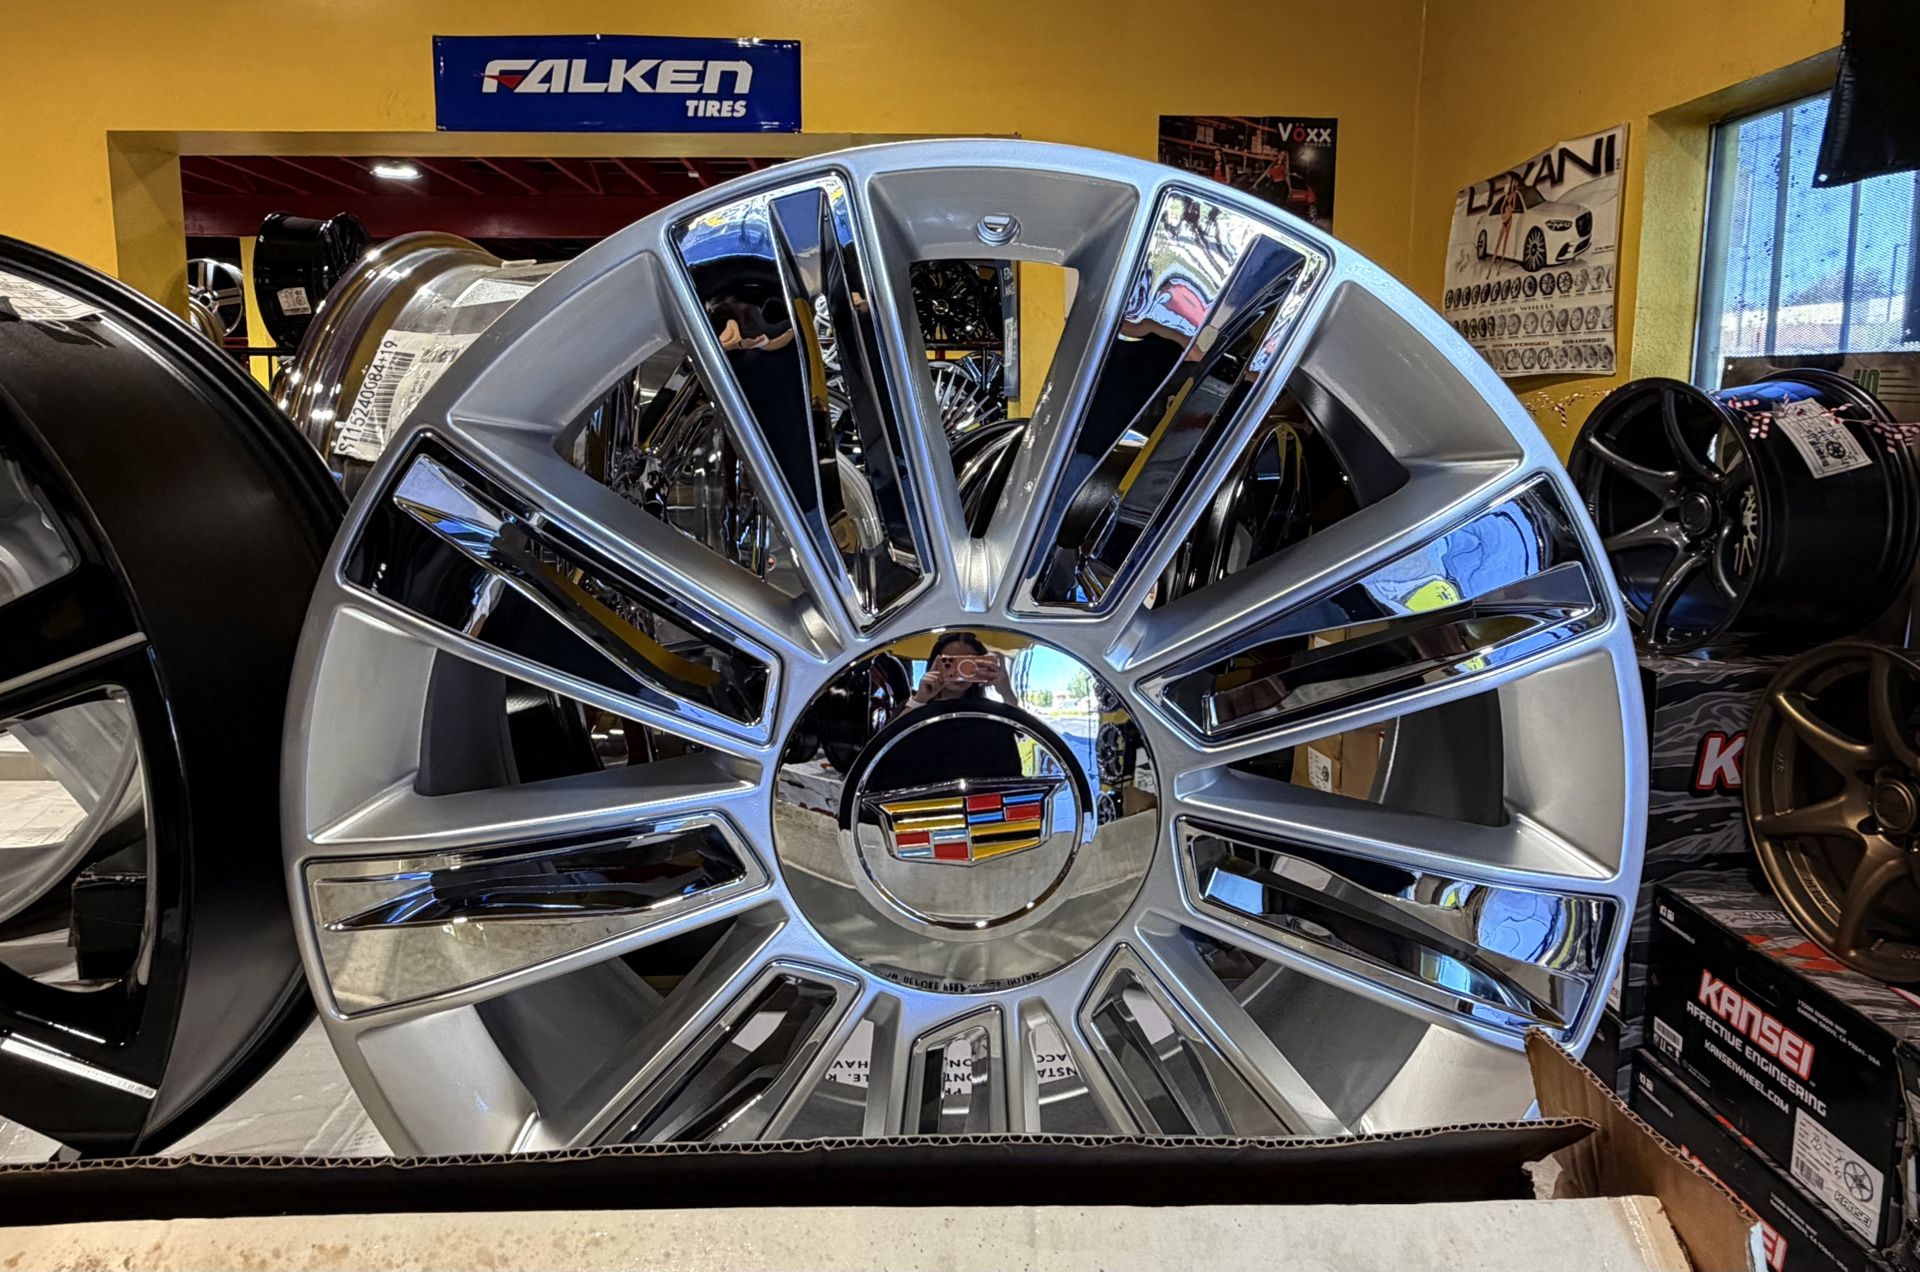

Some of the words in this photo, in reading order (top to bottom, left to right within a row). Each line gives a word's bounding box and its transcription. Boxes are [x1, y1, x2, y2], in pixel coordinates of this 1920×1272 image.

[481, 59, 754, 95] FALKEN
[686, 99, 748, 119] TIRES
[1686, 1000, 1743, 1052] AFFECTIVE
[1745, 1042, 1828, 1117] ENGINEERING
[1697, 968, 1815, 1082] KANSEI
